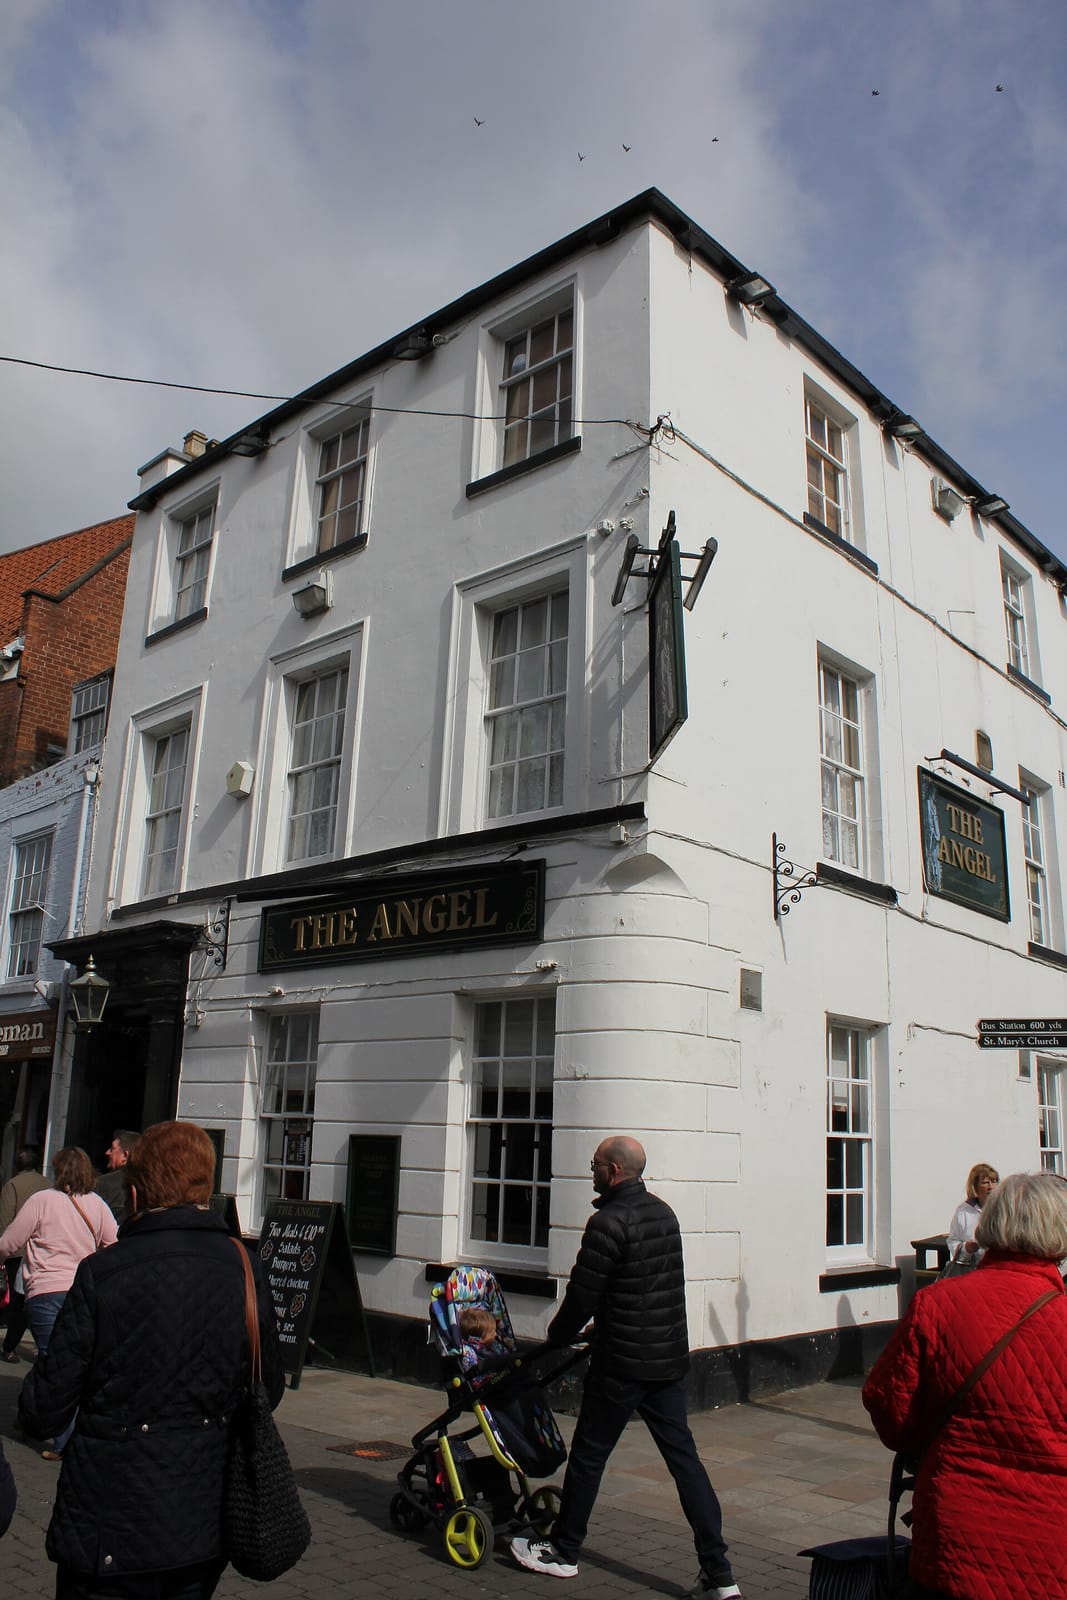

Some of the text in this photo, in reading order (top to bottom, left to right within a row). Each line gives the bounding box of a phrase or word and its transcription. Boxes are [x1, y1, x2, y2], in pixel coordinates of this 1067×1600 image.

[946, 803, 984, 845] THE
[938, 835, 996, 883] ANGEL
[290, 888, 497, 950] THE ANGEL
[981, 1021, 1062, 1031] Bus Station 600 yds
[983, 1036, 1059, 1047] St. Mary's Church
[278, 1206, 320, 1218] THE ANGEL
[278, 1241, 301, 1254] Salads
